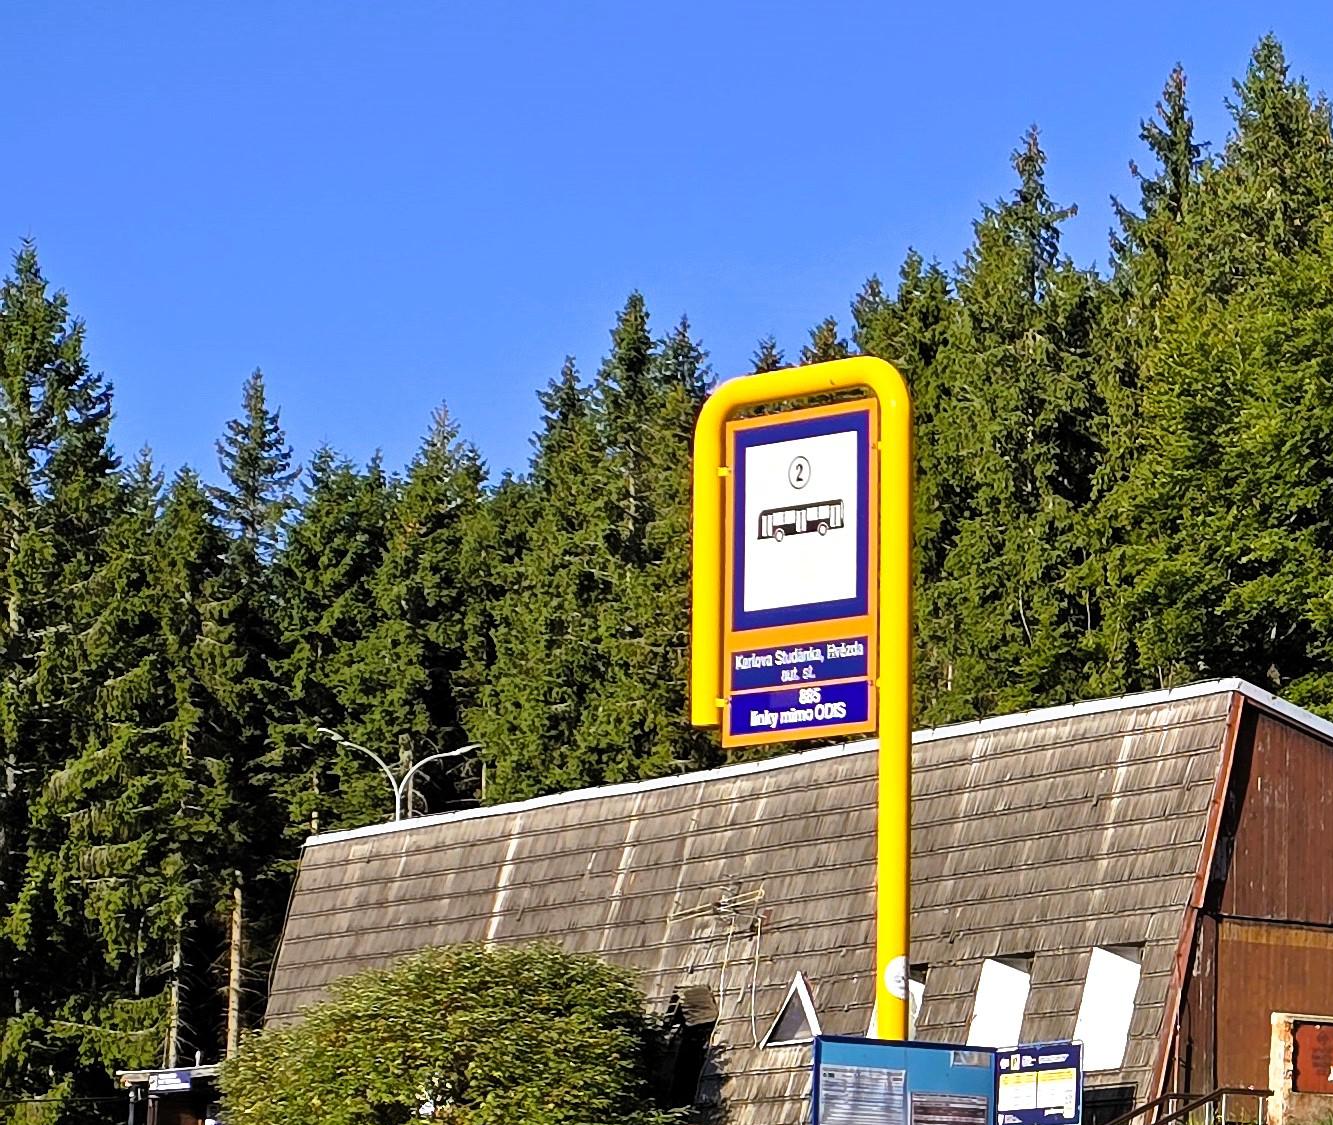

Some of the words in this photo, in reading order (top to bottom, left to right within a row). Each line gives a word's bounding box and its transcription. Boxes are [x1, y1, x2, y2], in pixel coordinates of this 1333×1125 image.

[795, 463, 804, 482] 2
[735, 653, 773, 670] Karlova
[750, 709, 779, 728] linky
[780, 708, 813, 724] mimo
[814, 702, 847, 720] ODIS
